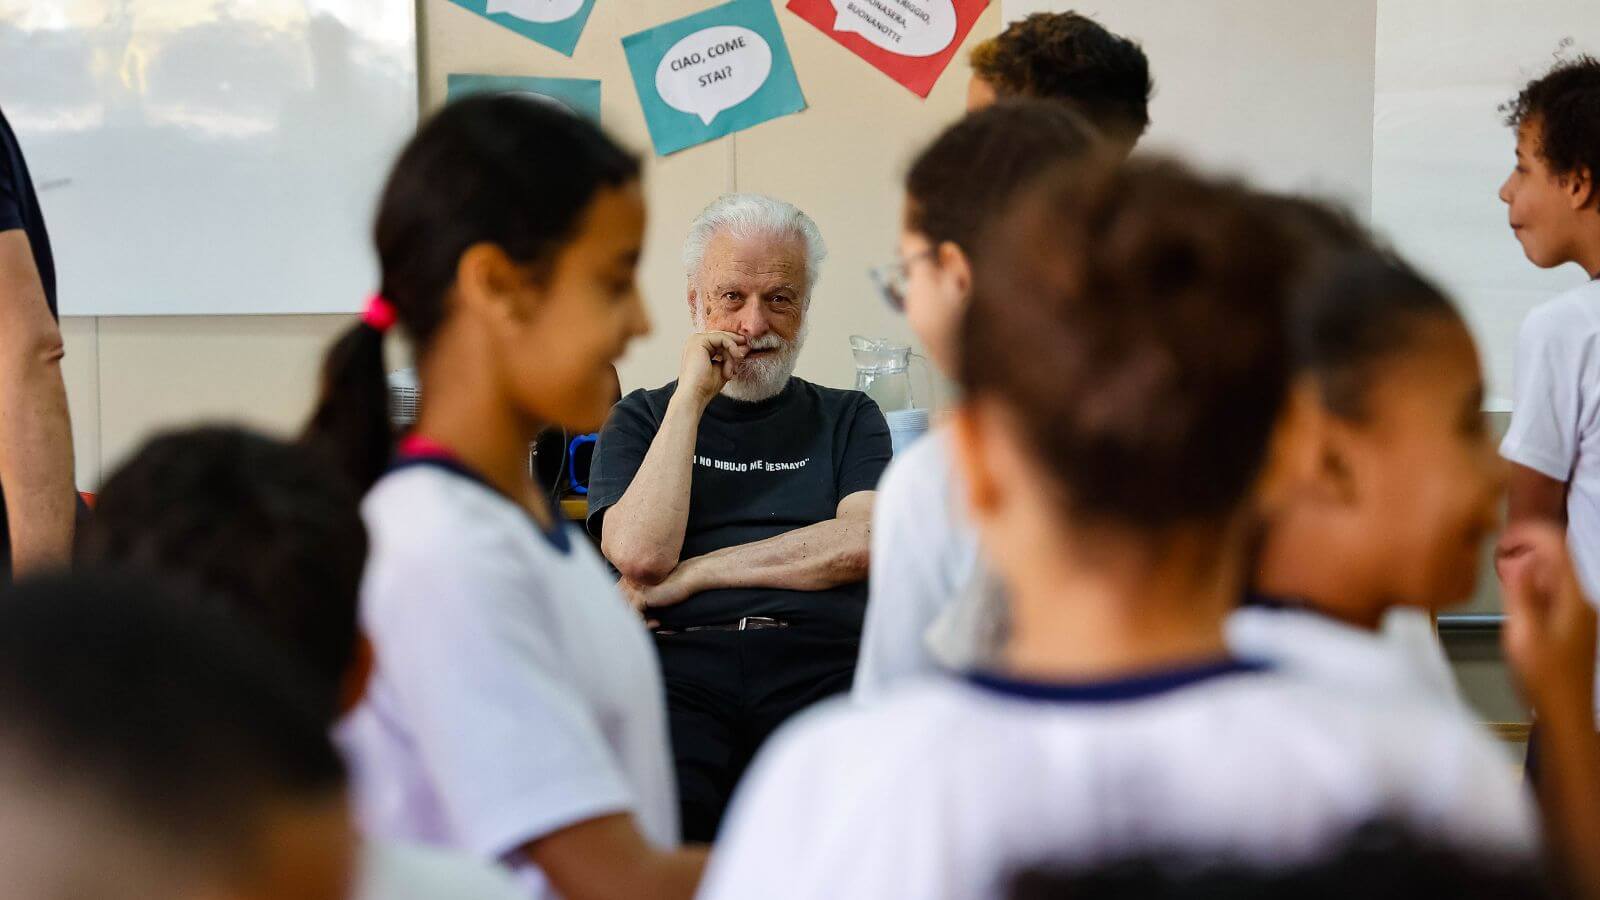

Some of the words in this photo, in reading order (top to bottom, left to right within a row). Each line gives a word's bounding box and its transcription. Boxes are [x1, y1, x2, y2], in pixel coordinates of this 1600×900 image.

[847, 2, 902, 43] BUONANOTTE
[866, 0, 906, 28] ONASERA,
[895, 0, 930, 24] RIGGIO,
[671, 53, 706, 71] CIAO,
[708, 36, 746, 58] COME
[698, 66, 732, 87] STAI?
[700, 456, 711, 467] NO
[714, 459, 747, 472] DIBUJO
[749, 460, 763, 471] ME
